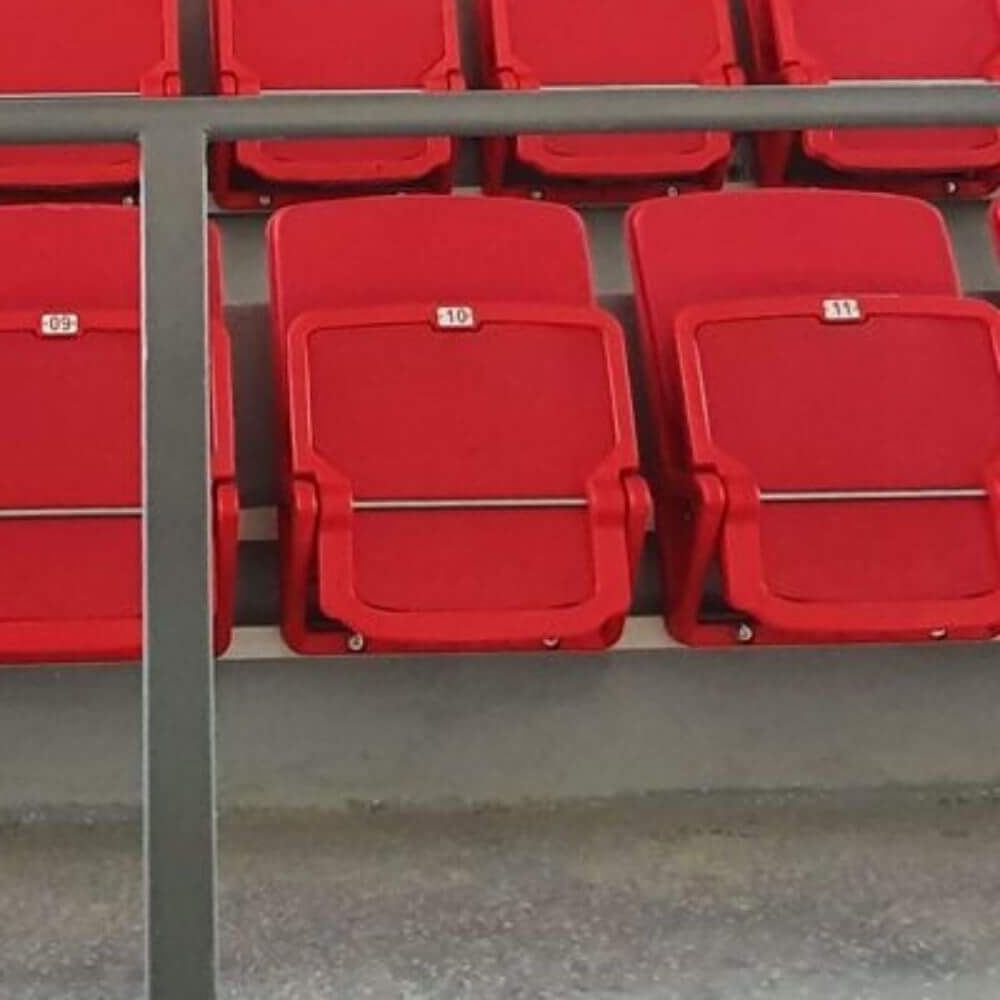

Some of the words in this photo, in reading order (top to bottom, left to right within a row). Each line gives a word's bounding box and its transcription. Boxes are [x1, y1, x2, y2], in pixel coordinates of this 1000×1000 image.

[831, 302, 852, 315] 11
[446, 309, 468, 323] 10
[49, 317, 71, 330] 09
